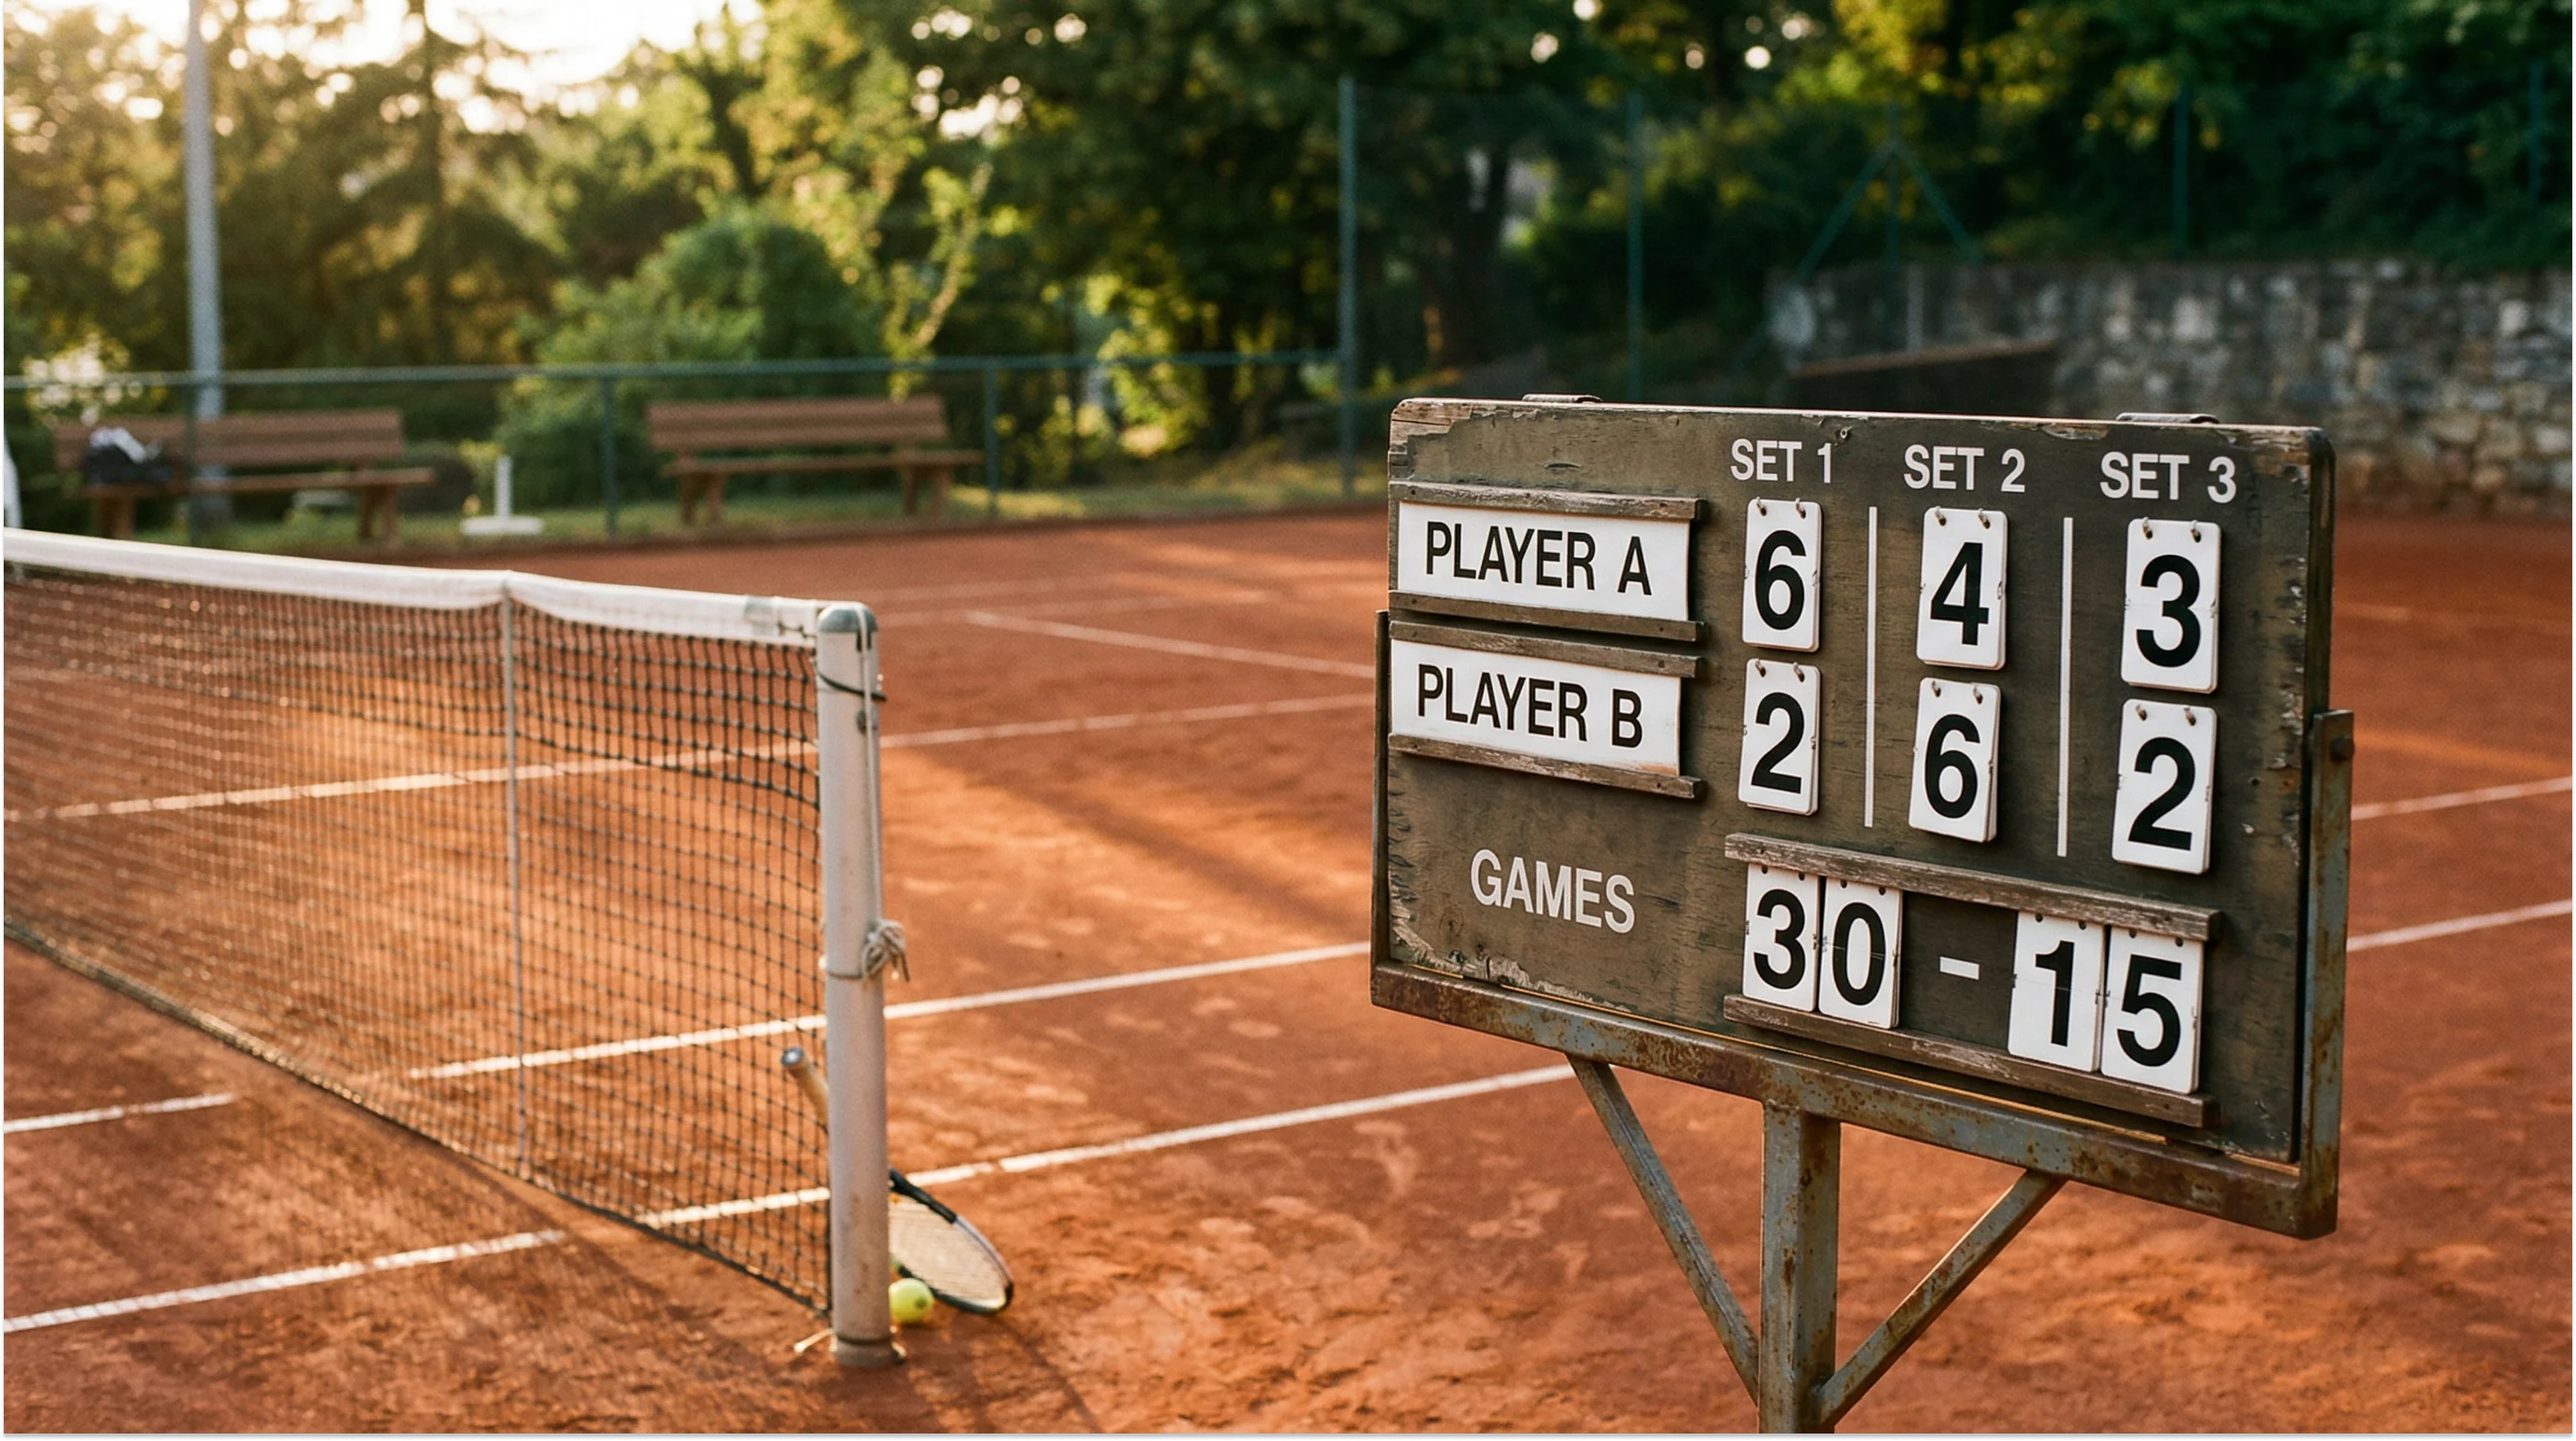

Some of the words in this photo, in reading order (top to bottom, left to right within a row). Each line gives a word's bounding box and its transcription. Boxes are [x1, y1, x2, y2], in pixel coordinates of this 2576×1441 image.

[1730, 439, 1801, 482] SET
[1818, 443, 1832, 483] 1
[1904, 444, 1983, 491] SET
[2001, 449, 2025, 493] 2
[2100, 451, 2190, 499] SET
[2207, 455, 2236, 504] 3
[1426, 522, 1596, 591] PLAYER
[1617, 536, 1652, 595] A
[1754, 529, 1807, 630] 6
[1930, 541, 1989, 646] 4
[2135, 554, 2202, 667] 3
[1418, 664, 1588, 742] PLAYER
[1612, 689, 1643, 748] B
[1750, 692, 1805, 794] 2
[1925, 714, 1981, 818] 6
[2128, 736, 2195, 851] 2
[1470, 848, 1635, 934] GAMES
[1752, 888, 1886, 1007] 30
[2034, 940, 2182, 1067] 15
